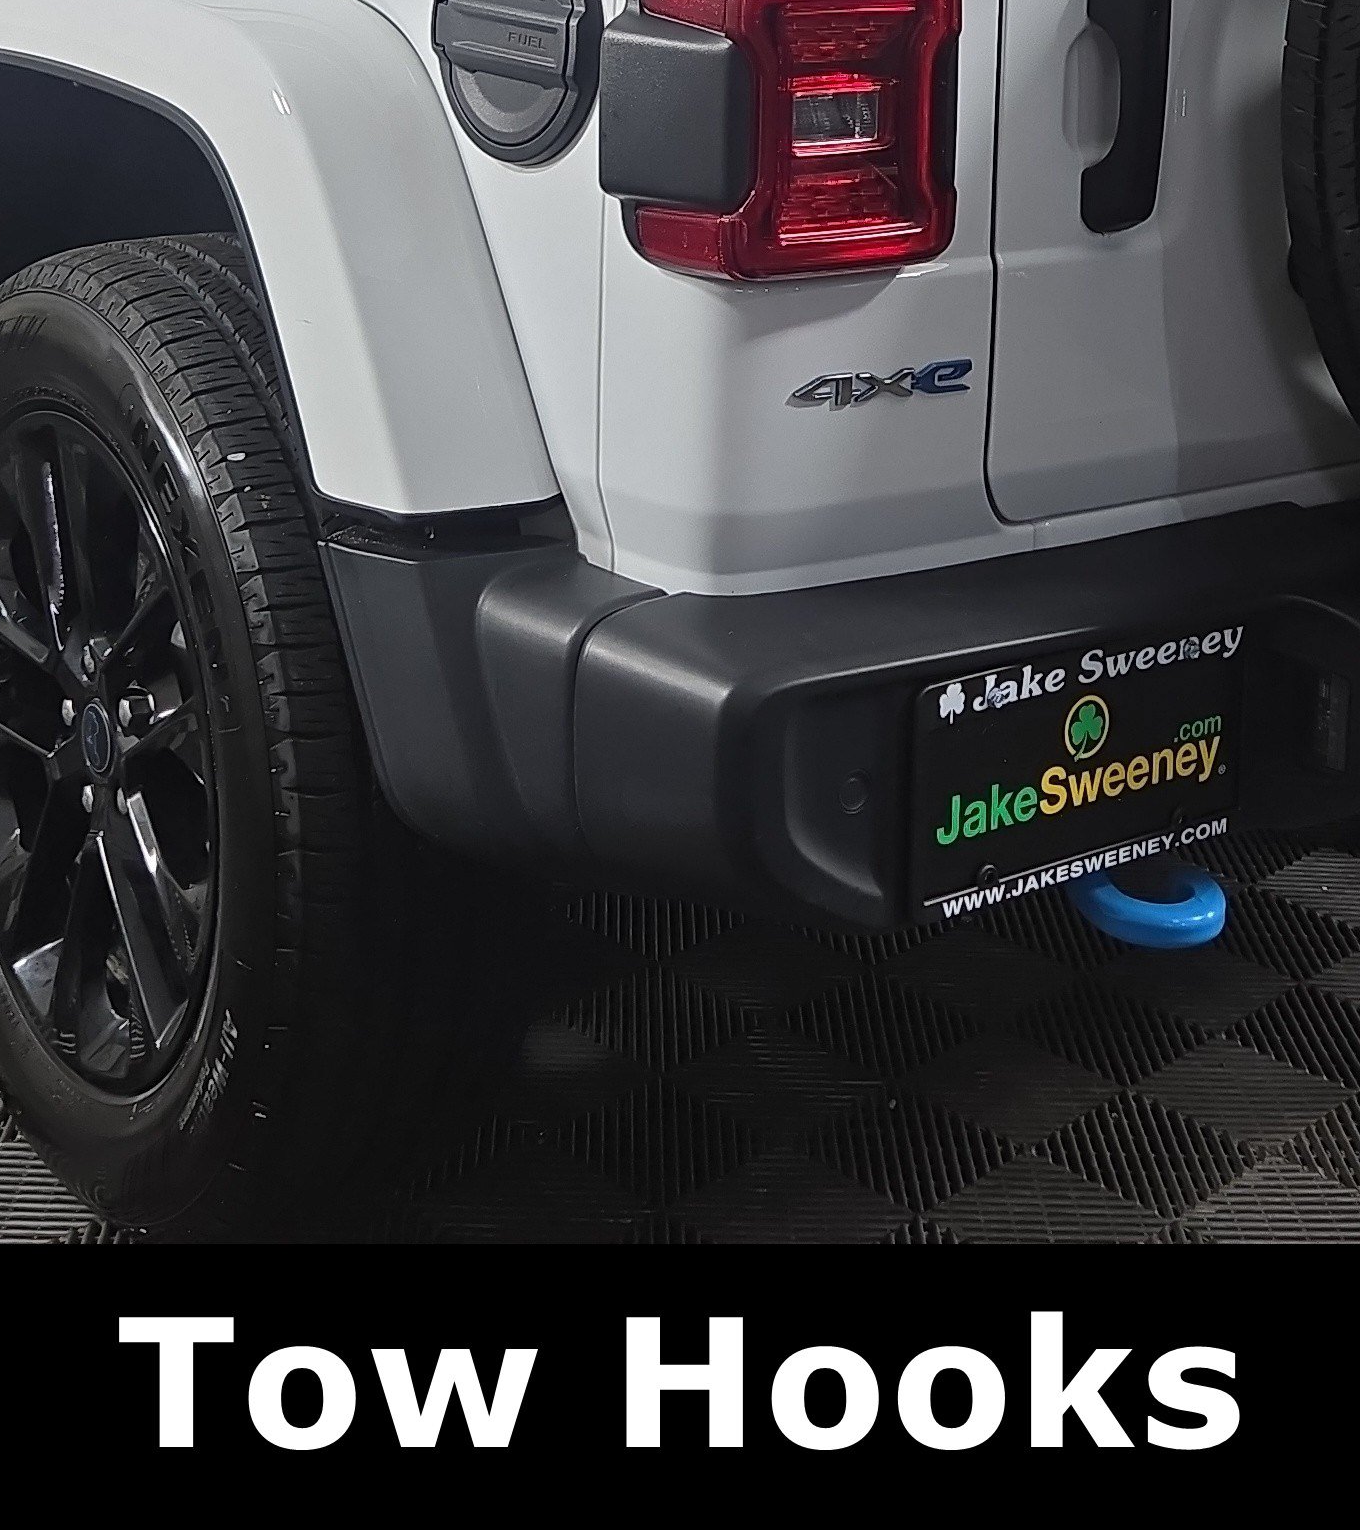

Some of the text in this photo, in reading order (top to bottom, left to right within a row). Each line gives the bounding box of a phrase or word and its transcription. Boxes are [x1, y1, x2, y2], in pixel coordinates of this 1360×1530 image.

[508, 31, 548, 49] FUEL
[972, 626, 1244, 712] Jake Sweeney
[941, 817, 1228, 919] WWW.JAKESWEENEY.COM
